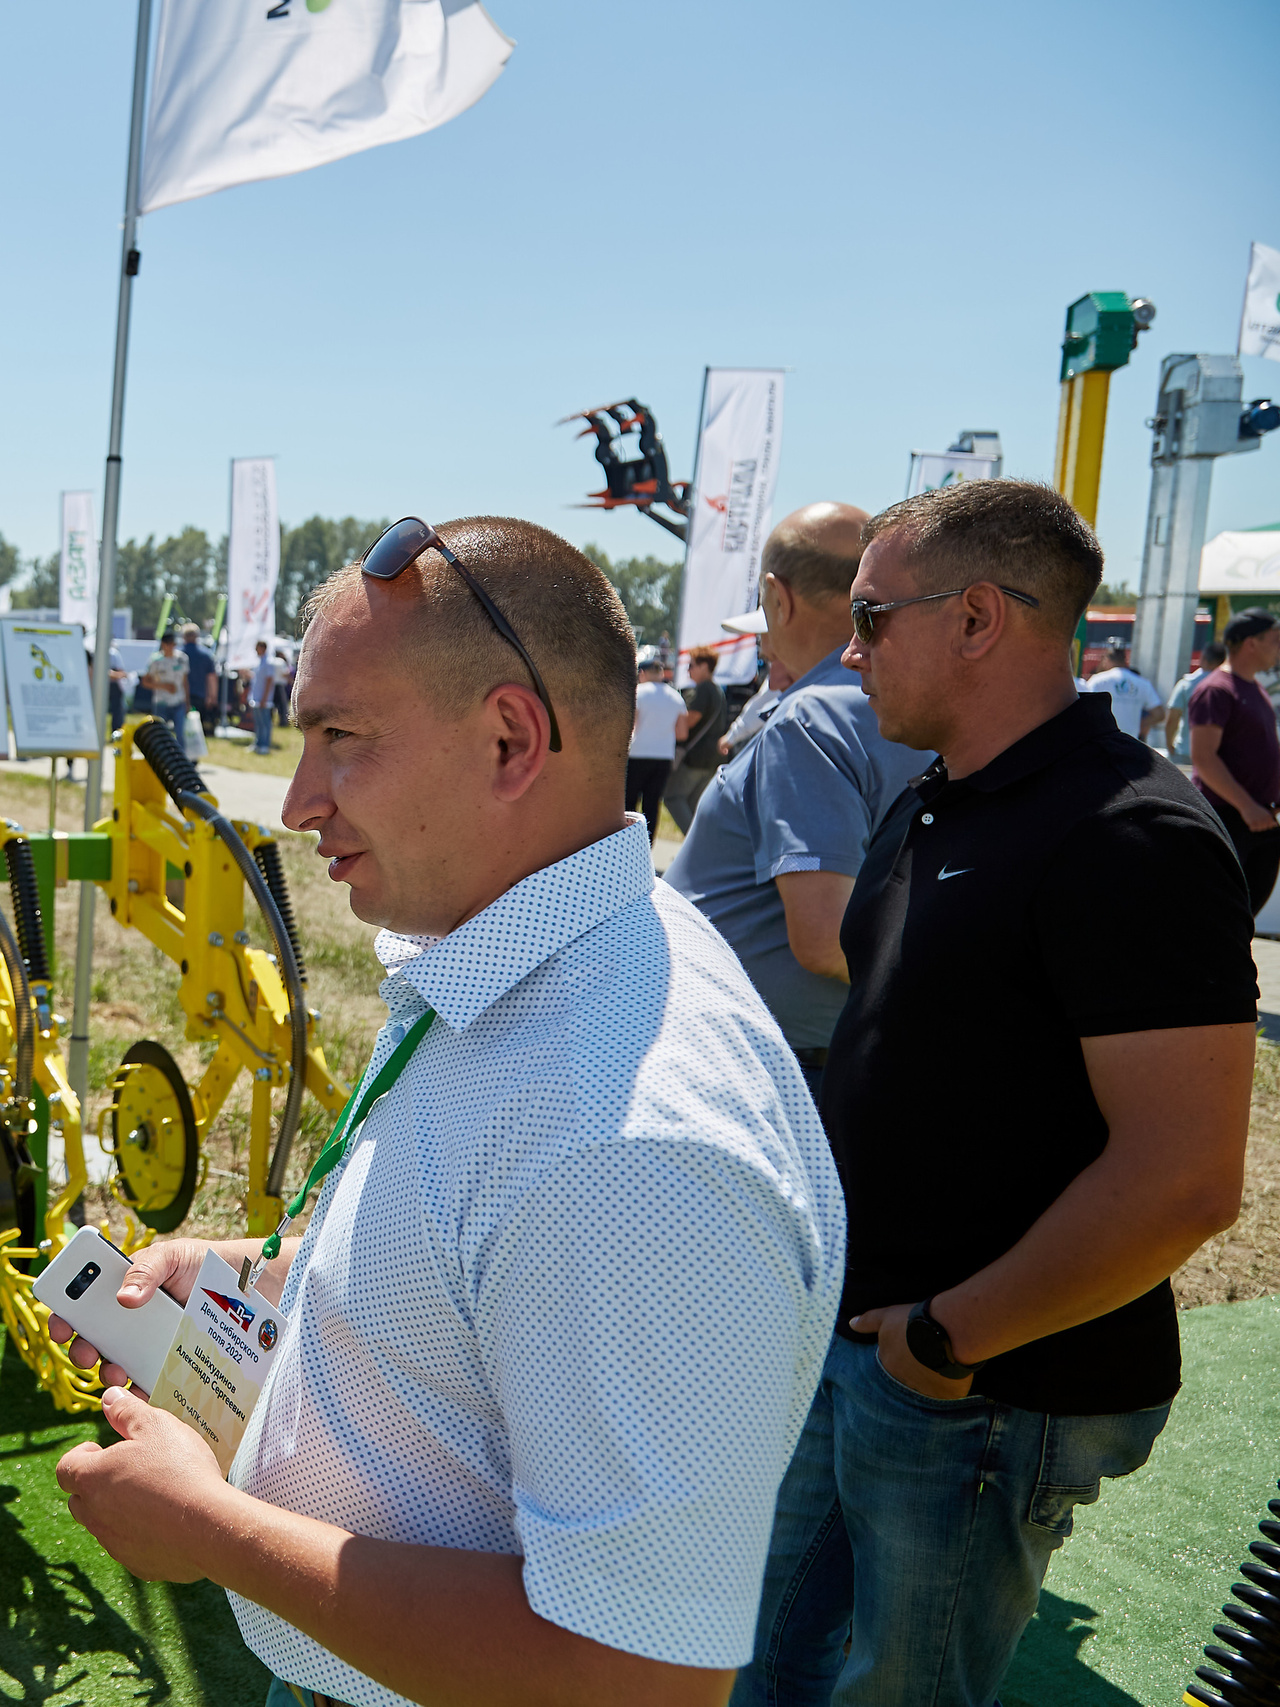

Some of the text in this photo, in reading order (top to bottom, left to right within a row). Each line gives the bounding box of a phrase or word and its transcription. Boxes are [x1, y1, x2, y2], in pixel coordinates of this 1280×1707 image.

[200, 1302, 259, 1363] День сибирского
[207, 1326, 243, 1364] поля 2022
[176, 1344, 246, 1422] Александр Сергеевич
[194, 1345, 237, 1394] Шайхудинов
[173, 1389, 187, 1407] ООО
